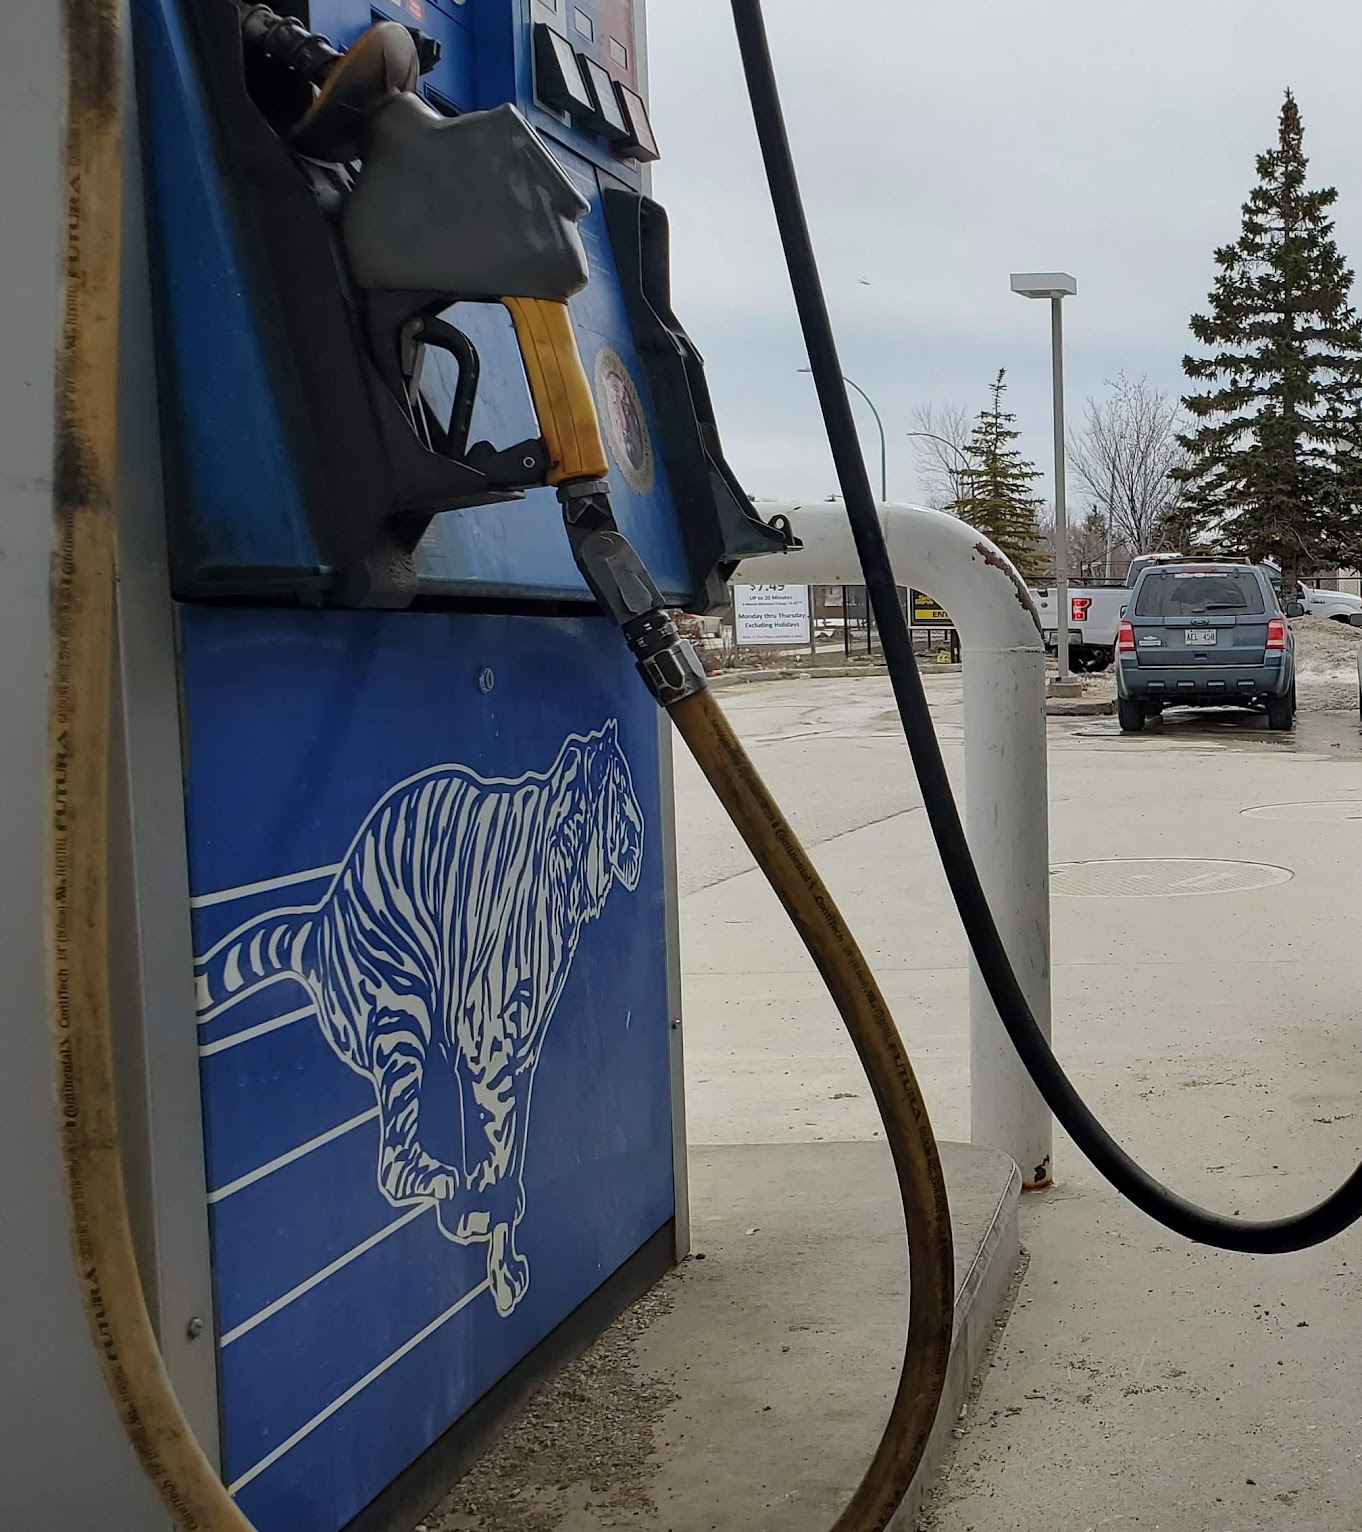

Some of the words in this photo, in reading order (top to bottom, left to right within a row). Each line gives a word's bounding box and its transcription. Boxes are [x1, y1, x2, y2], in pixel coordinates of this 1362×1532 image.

[67, 174, 81, 280] FUTURA
[778, 612, 806, 620] Thursday
[1187, 633, 1199, 641] AEL
[55, 731, 67, 831] FUTURA
[775, 829, 812, 883] Continental
[814, 895, 844, 943] ContiTech
[57, 969, 71, 1029] ContiTech
[60, 1050, 80, 1119] Continental
[889, 1043, 921, 1122] FUTURA
[84, 1266, 118, 1361] FUTURA
